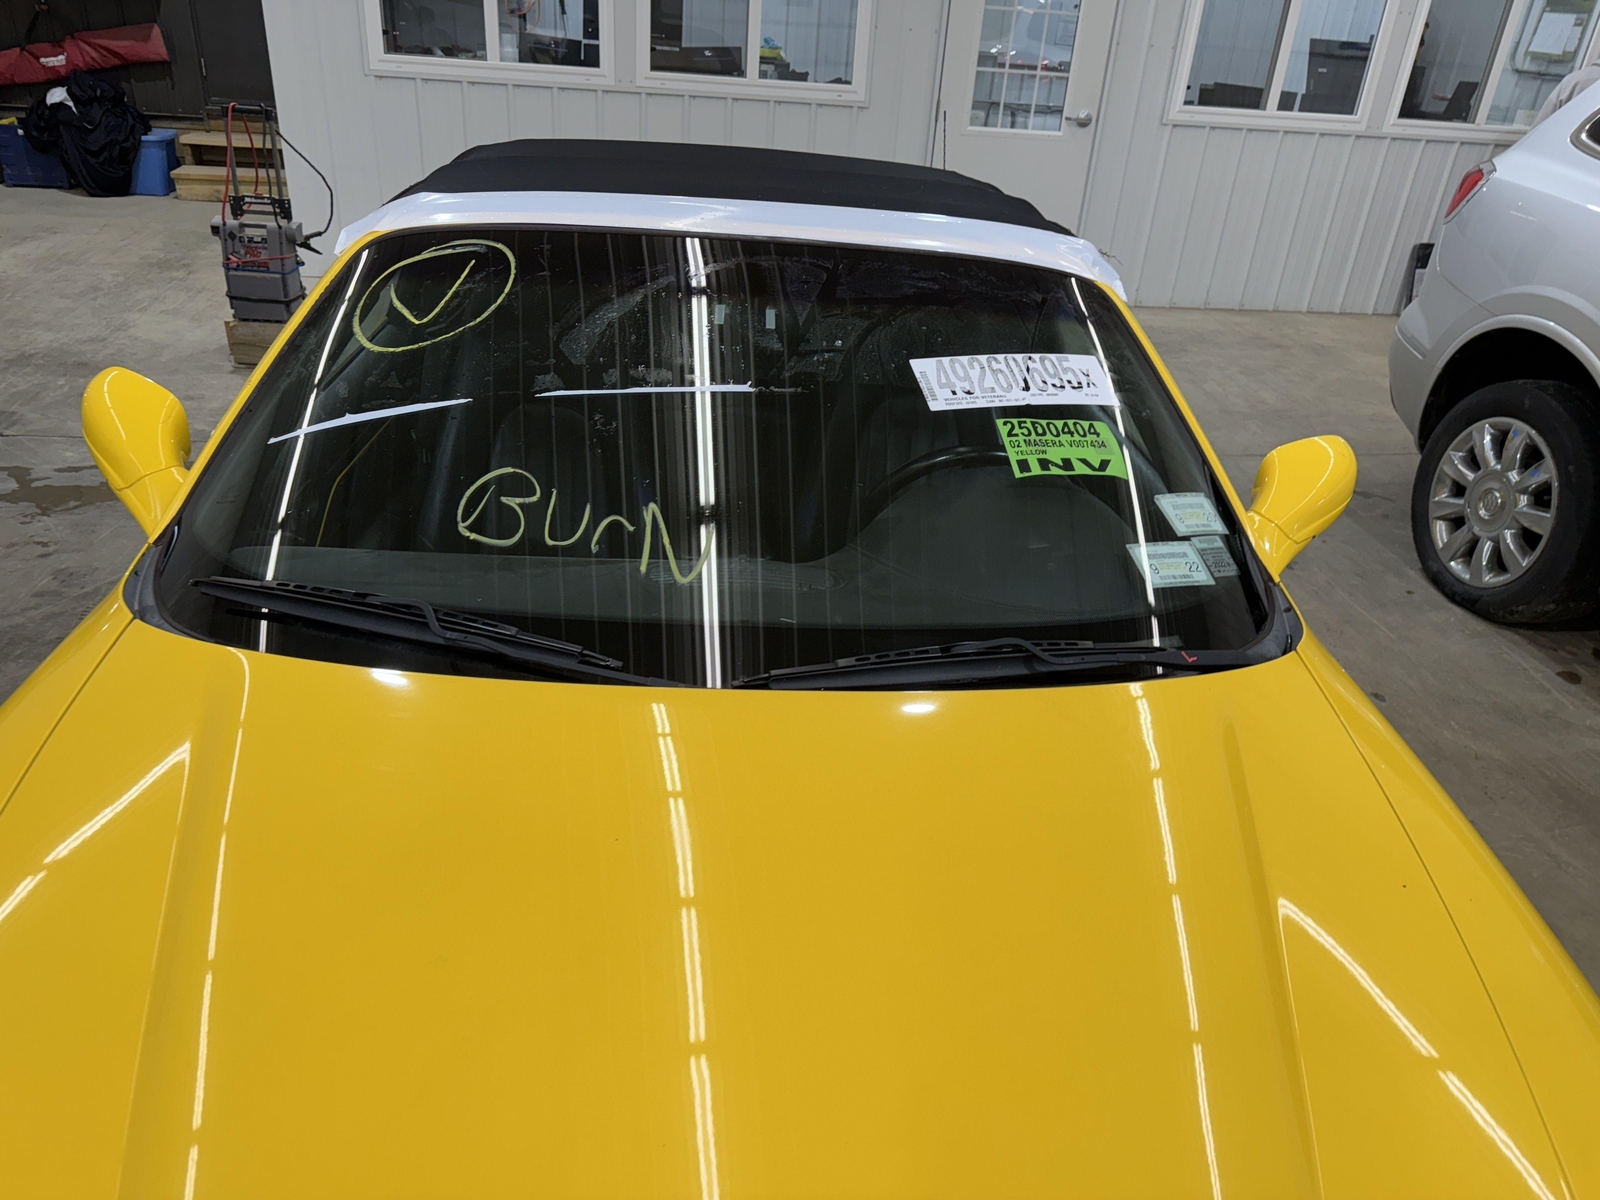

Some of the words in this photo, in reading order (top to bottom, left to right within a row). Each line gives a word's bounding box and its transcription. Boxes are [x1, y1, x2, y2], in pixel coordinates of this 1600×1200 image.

[1002, 420, 1101, 438] 25D0404
[1009, 440, 1023, 449] 02
[1024, 439, 1065, 449] MASERA
[1066, 439, 1107, 450] V007434
[1014, 449, 1048, 457] YELLOW
[1015, 458, 1112, 475] INV
[1184, 561, 1203, 573] 22
